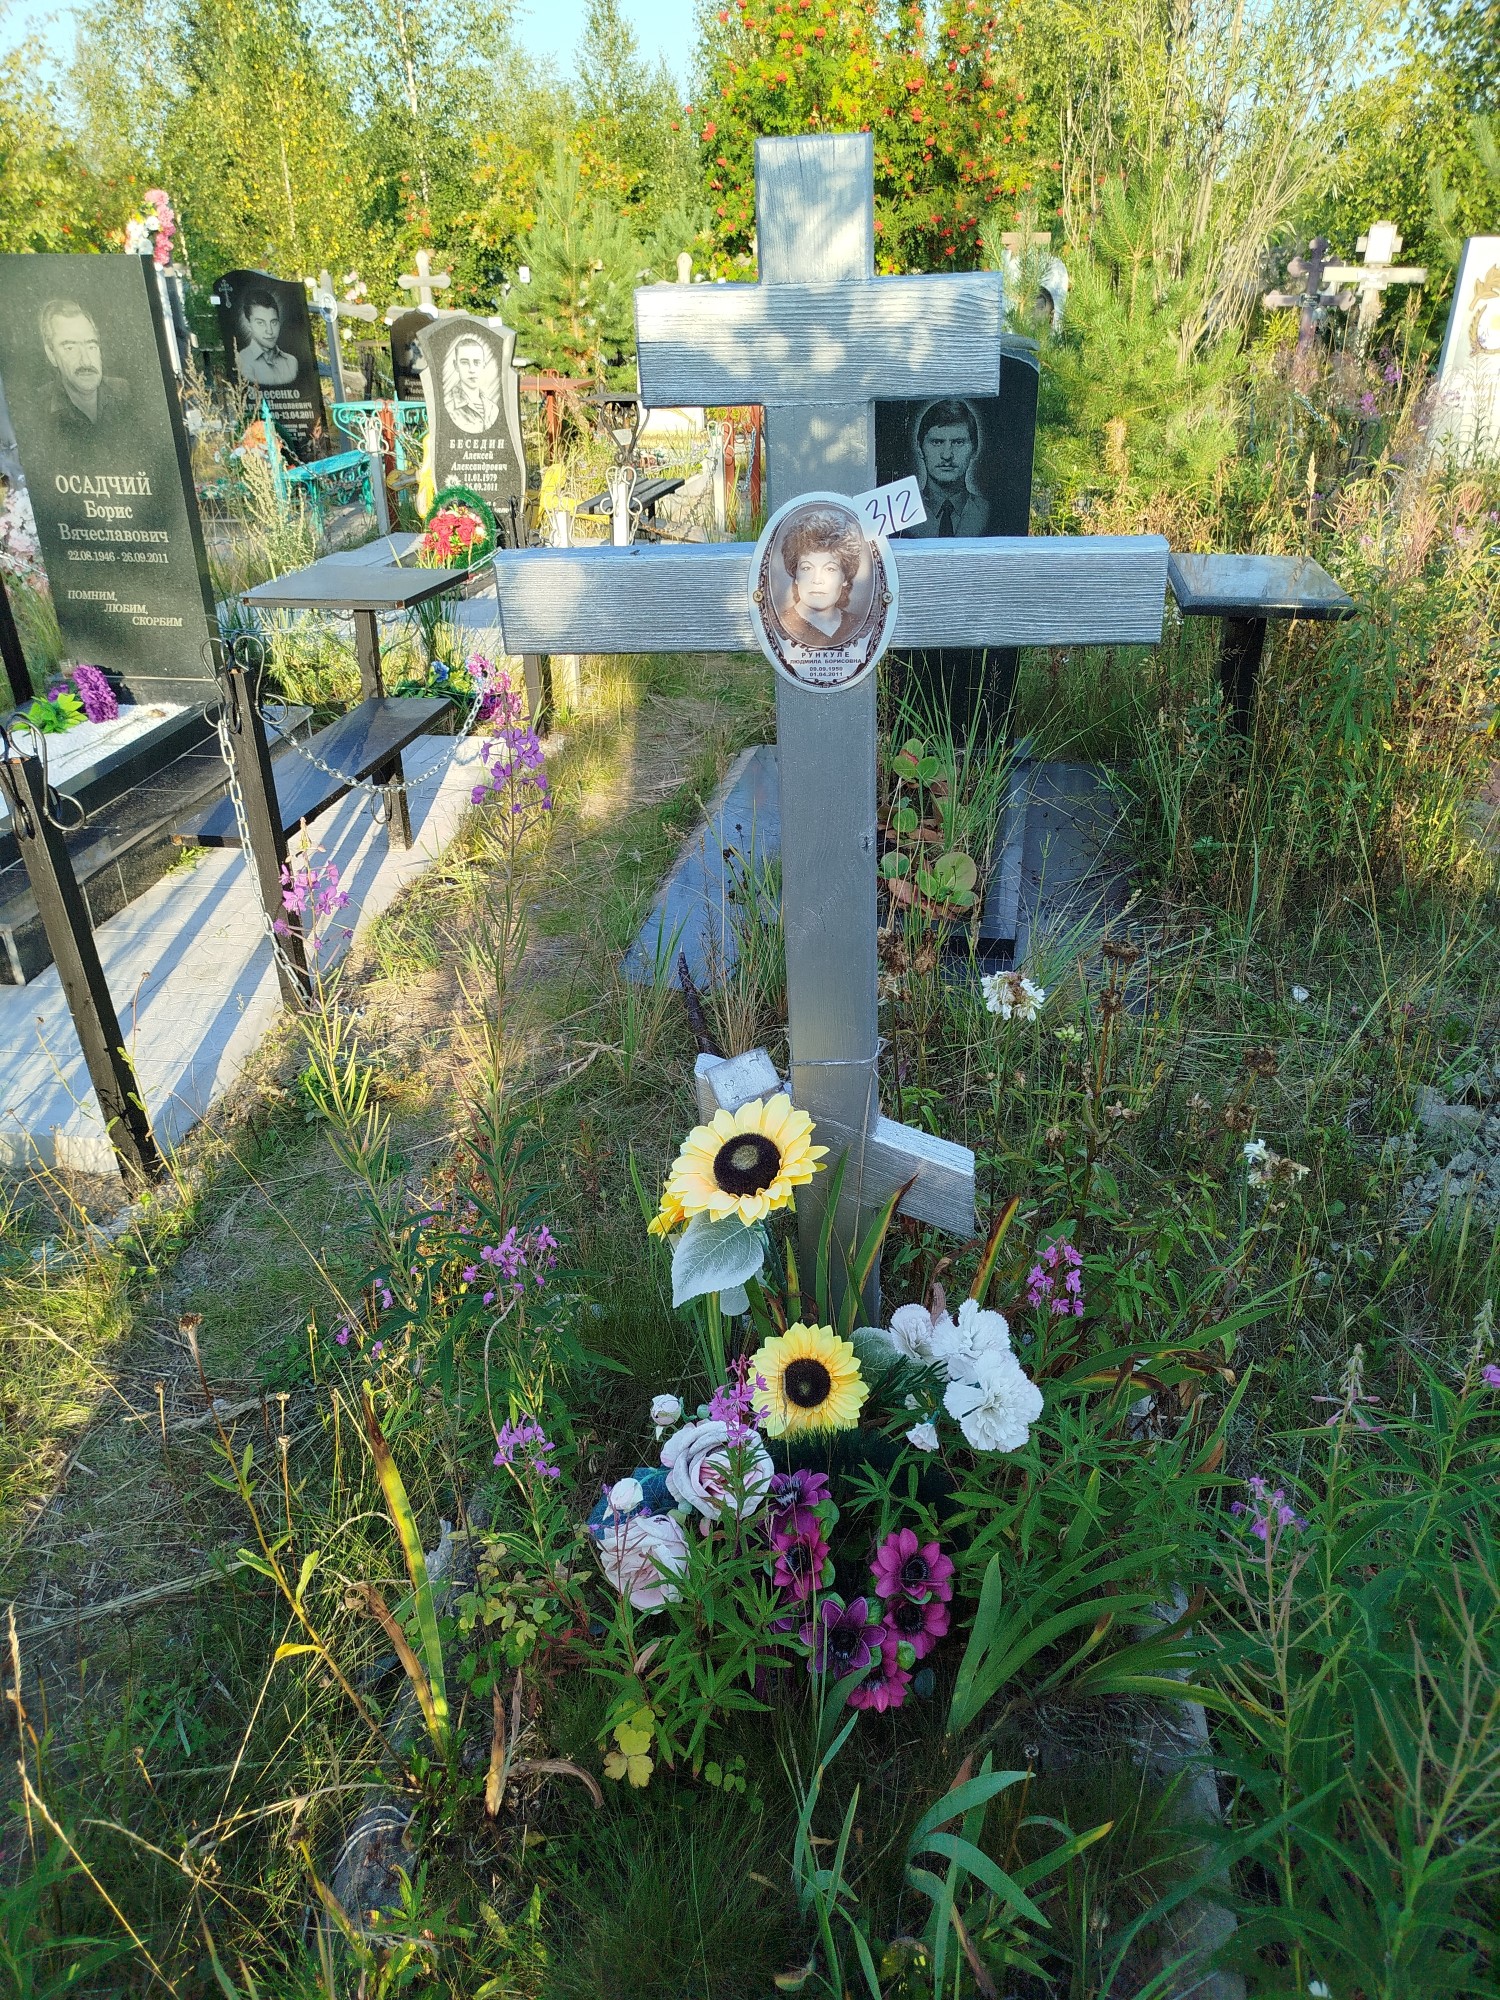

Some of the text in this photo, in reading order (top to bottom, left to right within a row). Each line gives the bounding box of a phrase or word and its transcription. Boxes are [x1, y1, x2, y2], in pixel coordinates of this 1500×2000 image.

[449, 439, 505, 450] БЕСЕДИН
[462, 451, 494, 460] Алексей
[451, 462, 508, 473] Александрович
[55, 471, 153, 498] ОСАДЧИЙ
[83, 500, 134, 521] Борис
[865, 490, 919, 536] 312
[57, 523, 170, 543] Вячеславович
[67, 550, 116, 562] 22.08.1946
[122, 552, 169, 563] 26.09.2011
[67, 590, 118, 601] ПОМНИМ,
[104, 603, 148, 614] ЛЮБИМ,
[132, 616, 183, 627] СКОРБИМ
